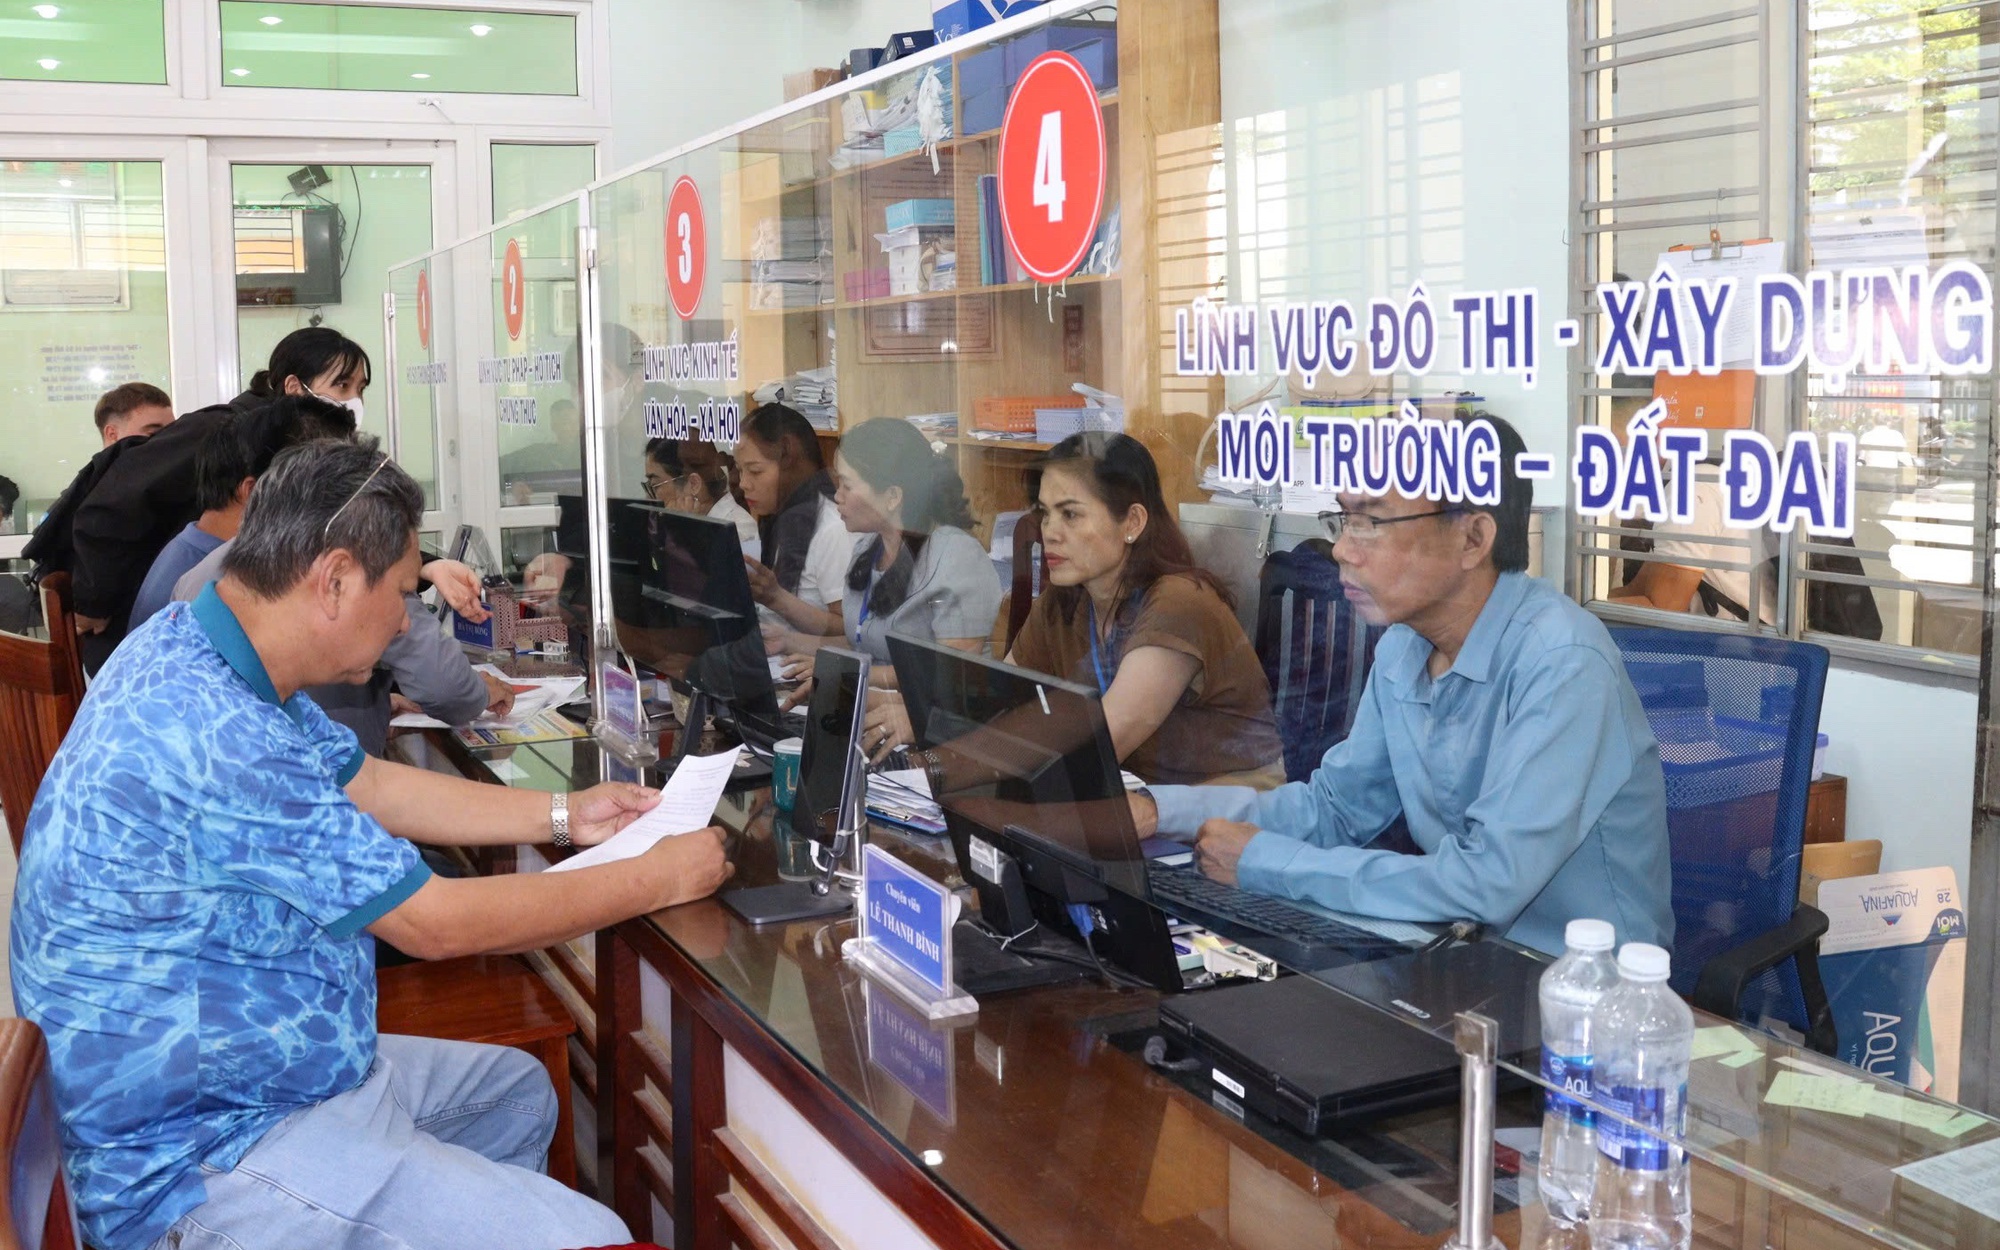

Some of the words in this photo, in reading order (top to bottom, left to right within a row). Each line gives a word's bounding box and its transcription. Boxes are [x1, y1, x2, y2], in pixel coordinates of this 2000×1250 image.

[1033, 111, 1066, 222] 4
[677, 212, 692, 284] 3
[421, 290, 426, 329] 1
[509, 264, 517, 315] 2
[643, 344, 665, 381] LĨNH
[667, 345, 689, 387] VỰC
[692, 343, 719, 380] KINH
[722, 330, 738, 379] TẾ
[1177, 301, 1255, 371] LĨNH
[1270, 305, 1354, 385] VỰC
[1370, 286, 1433, 370] ĐÔ
[1453, 294, 1534, 383] THỊ
[1600, 270, 1731, 369] XÂY
[1759, 269, 1986, 389] DỰNG
[644, 399, 663, 437] VĂN
[666, 396, 688, 440] HÓA
[699, 398, 715, 441] XÃ
[718, 397, 739, 449] HỘI
[1220, 407, 1291, 484] MÔI
[1306, 406, 1500, 500] TRƯỜNG
[1577, 406, 1701, 517] ĐẤT
[1725, 437, 1850, 529] ĐAI
[1859, 888, 1919, 913] AQUAFINA
[870, 901, 881, 923] LÊ
[882, 908, 914, 946] THANH
[915, 931, 939, 963] BÌNH
